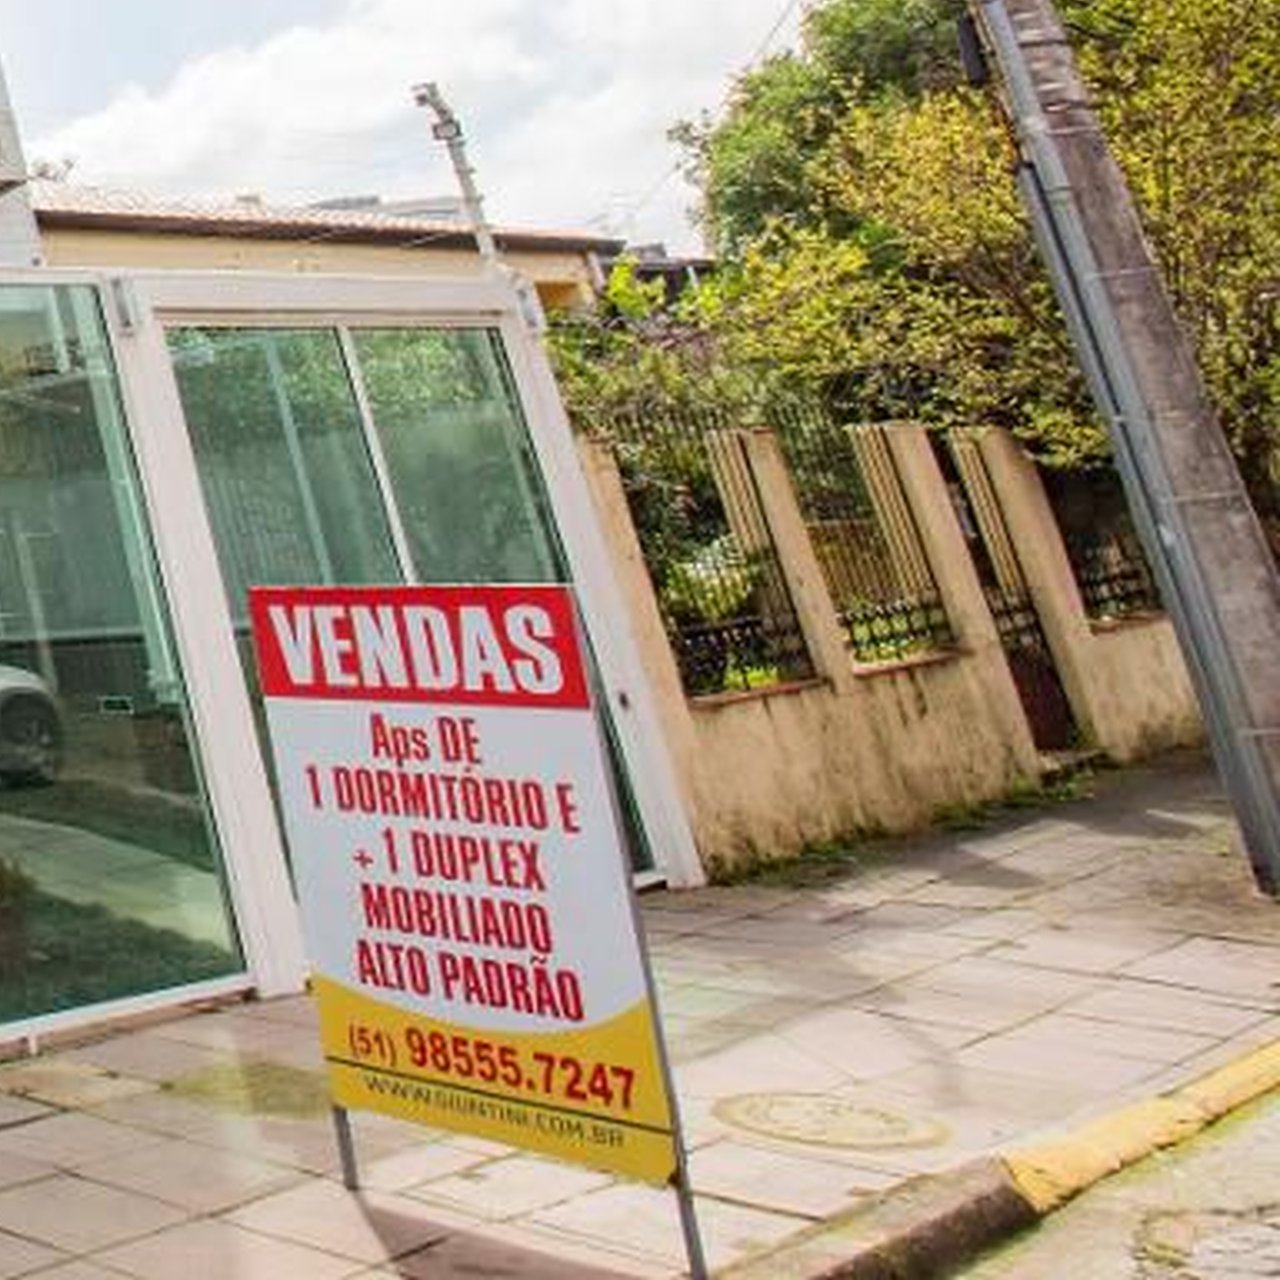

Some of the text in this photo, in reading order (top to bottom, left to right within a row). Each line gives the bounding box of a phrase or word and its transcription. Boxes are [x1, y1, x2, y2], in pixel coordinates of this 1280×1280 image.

[267, 603, 565, 696] VENDAS
[369, 712, 482, 768] Aps DE
[305, 764, 582, 834] 1 DORMITÓRIO E
[352, 826, 547, 892] + 1 DUPLEX
[360, 882, 553, 955] MOBILIADO
[356, 938, 585, 1022] ALTO PADRÃO
[348, 1022, 636, 1111] (51) 98555.7247
